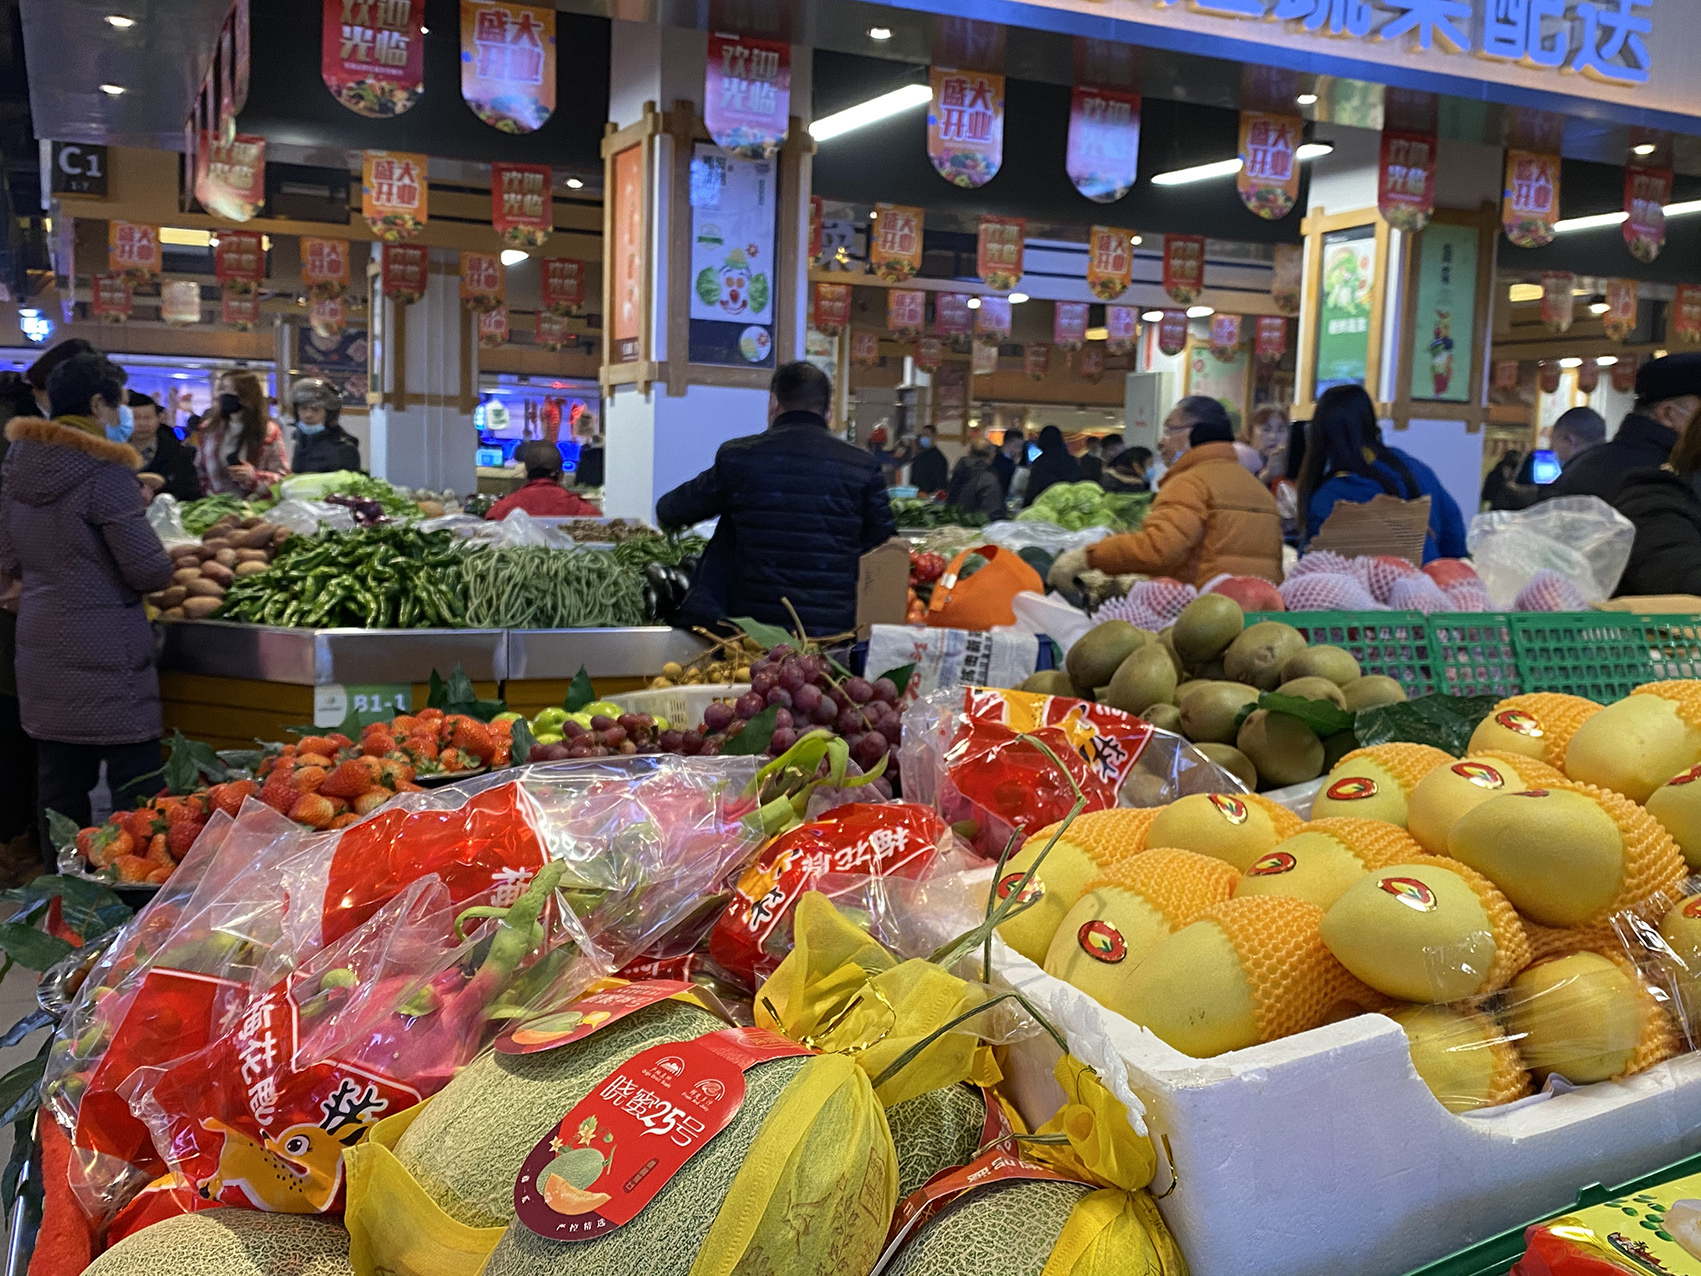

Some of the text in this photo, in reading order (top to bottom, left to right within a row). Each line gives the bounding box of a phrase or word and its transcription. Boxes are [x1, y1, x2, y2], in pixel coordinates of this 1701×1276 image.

[475, 9, 543, 48] 盛大
[339, 26, 411, 67] 光临
[721, 45, 780, 80] 欢迎
[719, 78, 777, 115] 光临
[940, 77, 993, 113] 盛大
[938, 110, 992, 142] 开业
[1250, 119, 1292, 149] 盛大
[58, 147, 102, 178] C1
[372, 158, 418, 184] 盛大
[1247, 147, 1292, 178] 开业
[371, 182, 418, 206] 开业
[353, 694, 406, 713] B1-1
[801, 826, 910, 876] 梅花鹿
[237, 992, 278, 1127] 梅花鹿
[599, 1074, 706, 1147] 晓蜜25号
